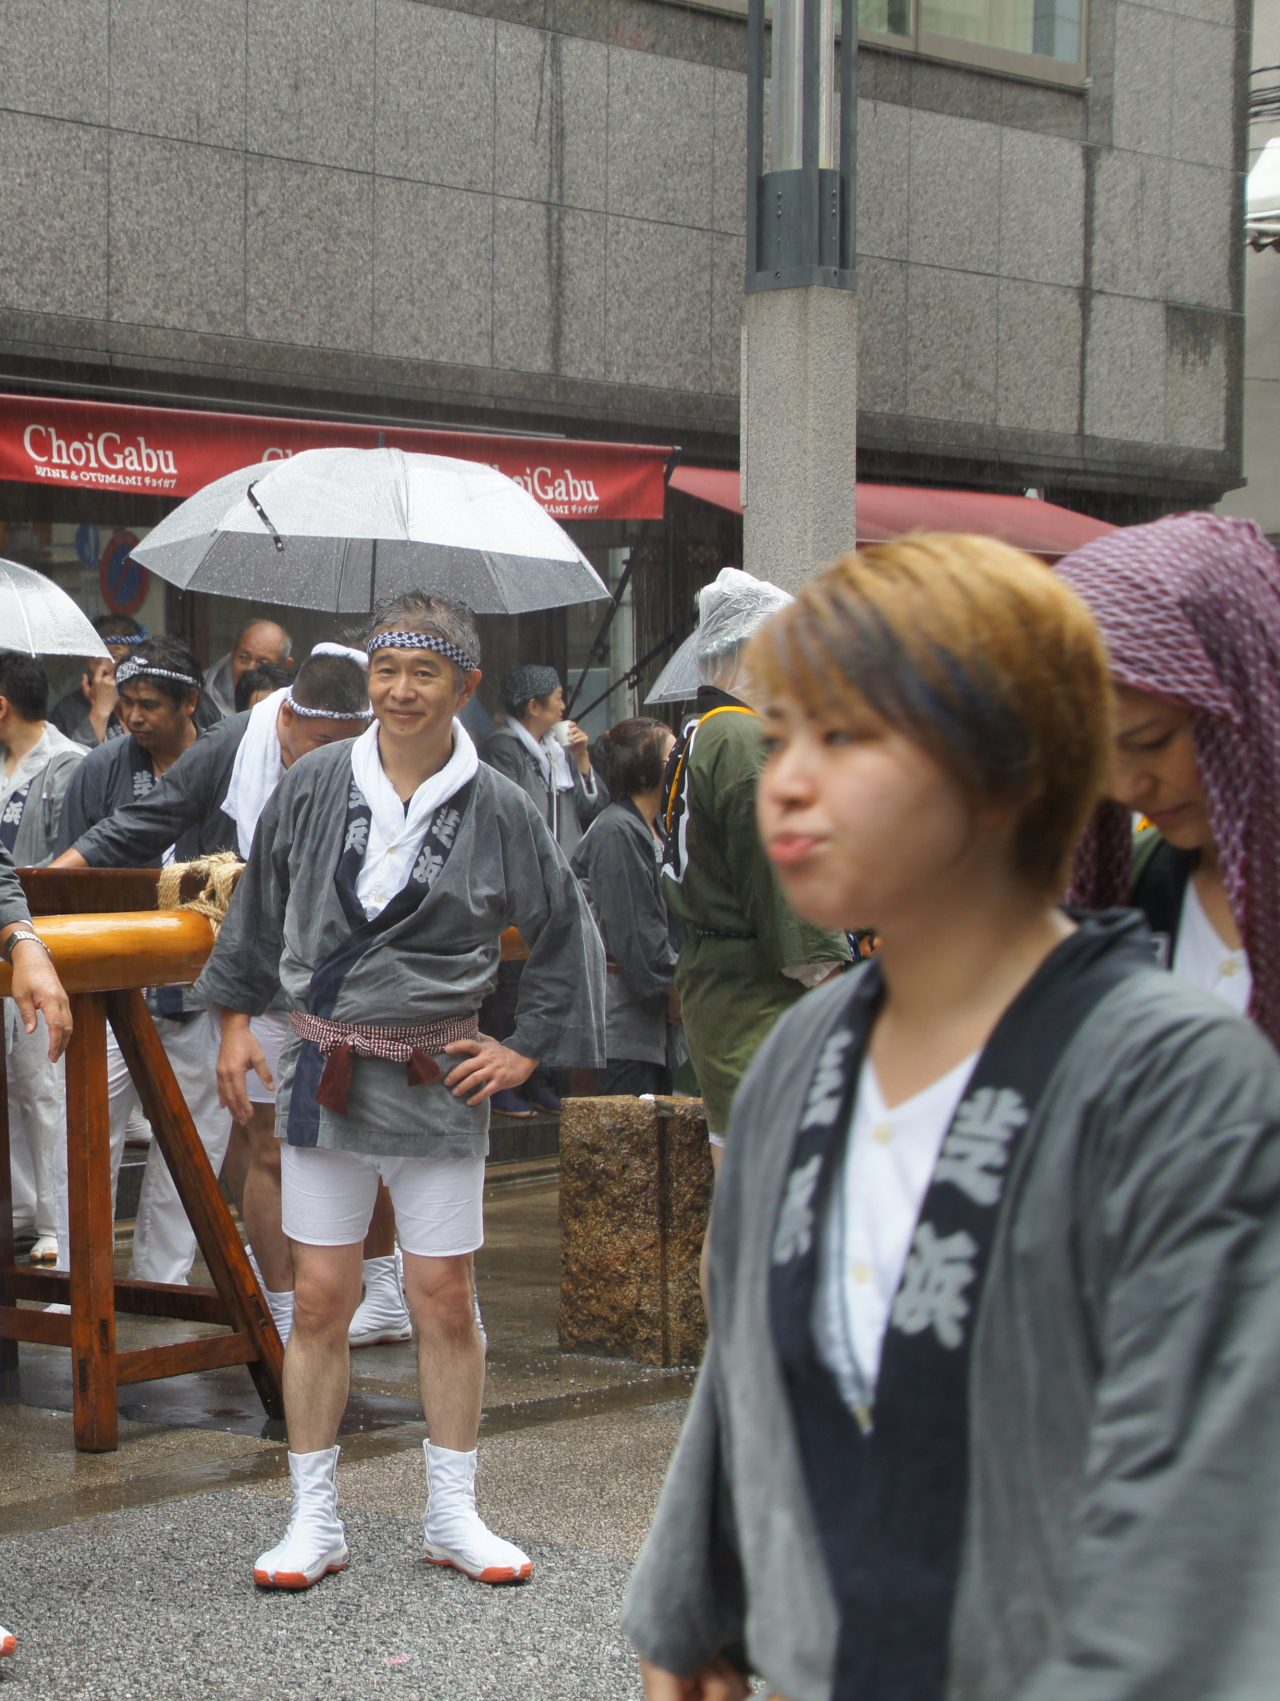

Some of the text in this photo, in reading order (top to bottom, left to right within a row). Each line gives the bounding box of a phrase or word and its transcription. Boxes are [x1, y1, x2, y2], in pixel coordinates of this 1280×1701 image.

[23, 424, 177, 474] ChoiGabu
[34, 465, 69, 480] WINE
[70, 470, 78, 481] &
[80, 471, 142, 486] OTUMAMI
